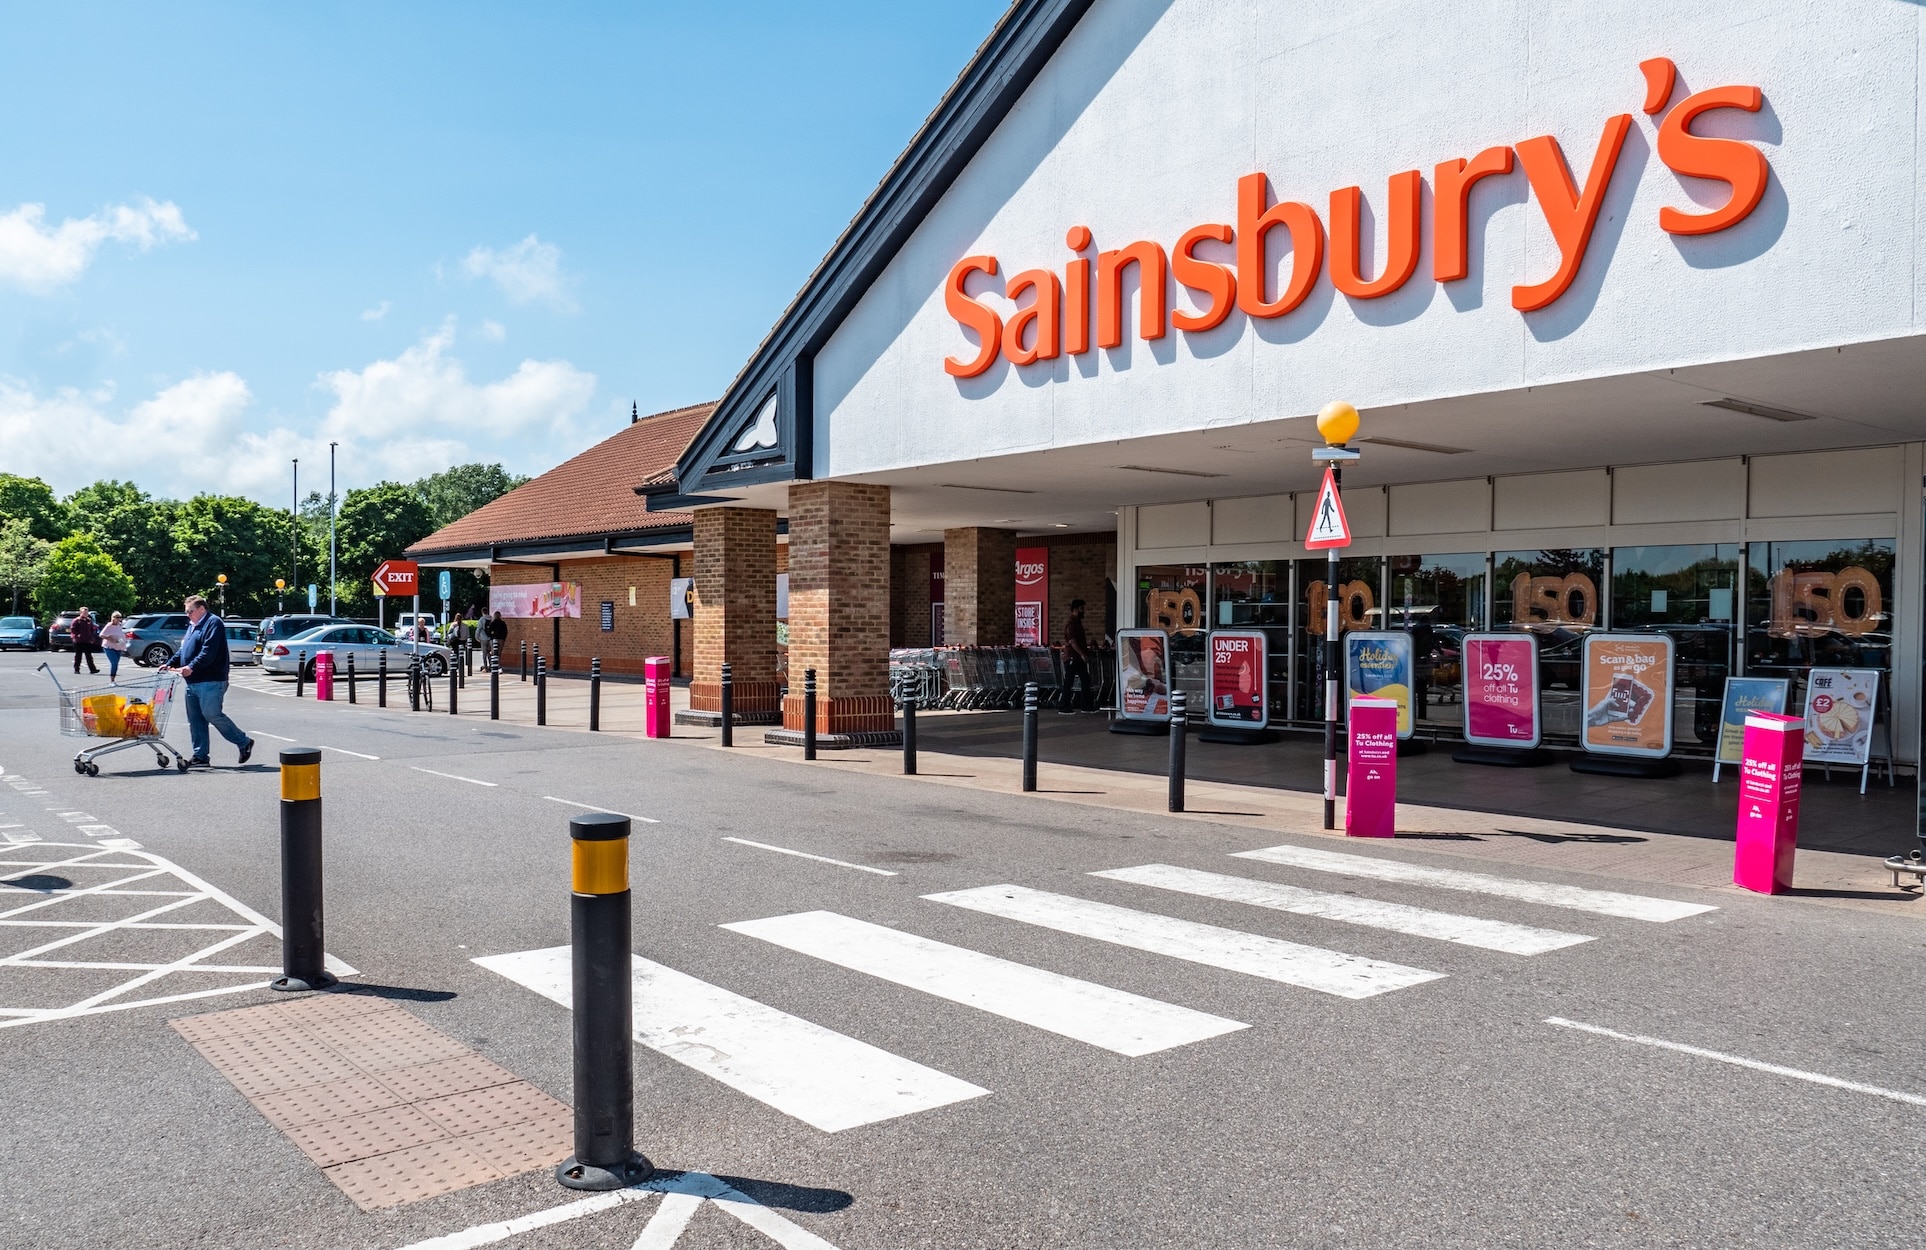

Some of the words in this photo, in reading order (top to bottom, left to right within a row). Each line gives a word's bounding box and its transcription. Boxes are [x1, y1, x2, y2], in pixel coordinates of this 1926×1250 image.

[944, 57, 1768, 379] Sainsbury's
[1015, 561, 1044, 579] Argos
[388, 573, 414, 582] EXIT
[1510, 571, 1597, 634] 150
[1766, 566, 1882, 638] 150
[1018, 607, 1035, 617] STORE
[1146, 587, 1201, 637] 150
[1215, 640, 1249, 652] UNDER
[1215, 652, 1232, 663] 25?
[1359, 647, 1398, 665] Holiday
[1600, 655, 1625, 664] Scan
[1626, 655, 1634, 664] &
[1634, 654, 1656, 665] bag
[1483, 663, 1518, 681] 25%
[1633, 664, 1647, 674] go
[1484, 684, 1495, 692] off
[1496, 684, 1506, 693] all
[1507, 683, 1518, 693] Tu
[1815, 677, 1832, 687] CAFÉ
[1484, 694, 1518, 706] clothing
[1816, 699, 1830, 707] £2
[1507, 724, 1517, 734] Tu
[1365, 740, 1394, 748] Clothing
[1745, 758, 1757, 767] 25%
[1758, 761, 1767, 769] off
[1768, 763, 1776, 771] all
[1751, 768, 1776, 781] Clothing
